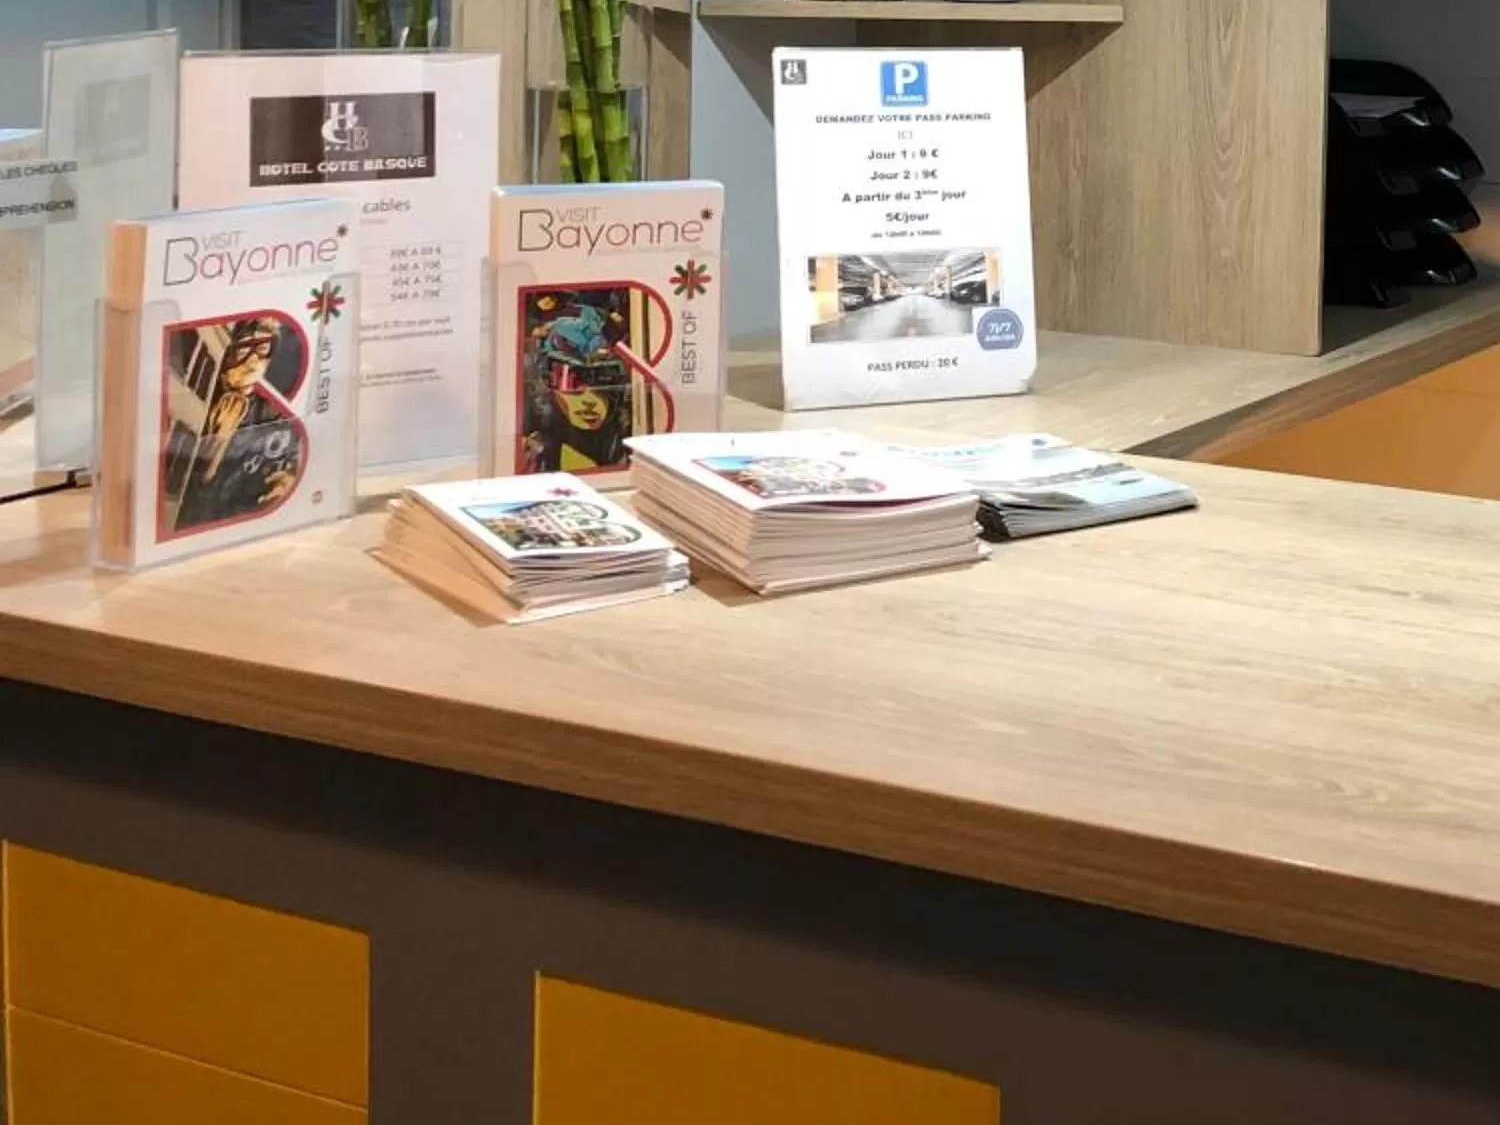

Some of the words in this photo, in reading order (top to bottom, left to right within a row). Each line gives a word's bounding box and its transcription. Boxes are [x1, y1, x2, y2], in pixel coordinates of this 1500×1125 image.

[895, 62, 920, 95] P
[259, 161, 314, 176] HOTEL
[363, 155, 428, 173] BASQUE
[867, 149, 896, 161] Jour
[869, 169, 899, 181] Jour
[902, 169, 912, 180] 2
[855, 191, 891, 204] partir
[894, 190, 911, 202] du
[941, 189, 967, 203] jour
[554, 206, 601, 223] VISIT
[202, 230, 244, 250] VISIT
[517, 208, 704, 256] Bayonne
[162, 236, 339, 287] Bayonne
[681, 309, 698, 336] OF
[680, 338, 697, 385] BEST
[867, 360, 893, 372] PASS
[895, 358, 929, 371] PERDU
[316, 366, 332, 415] BEST
